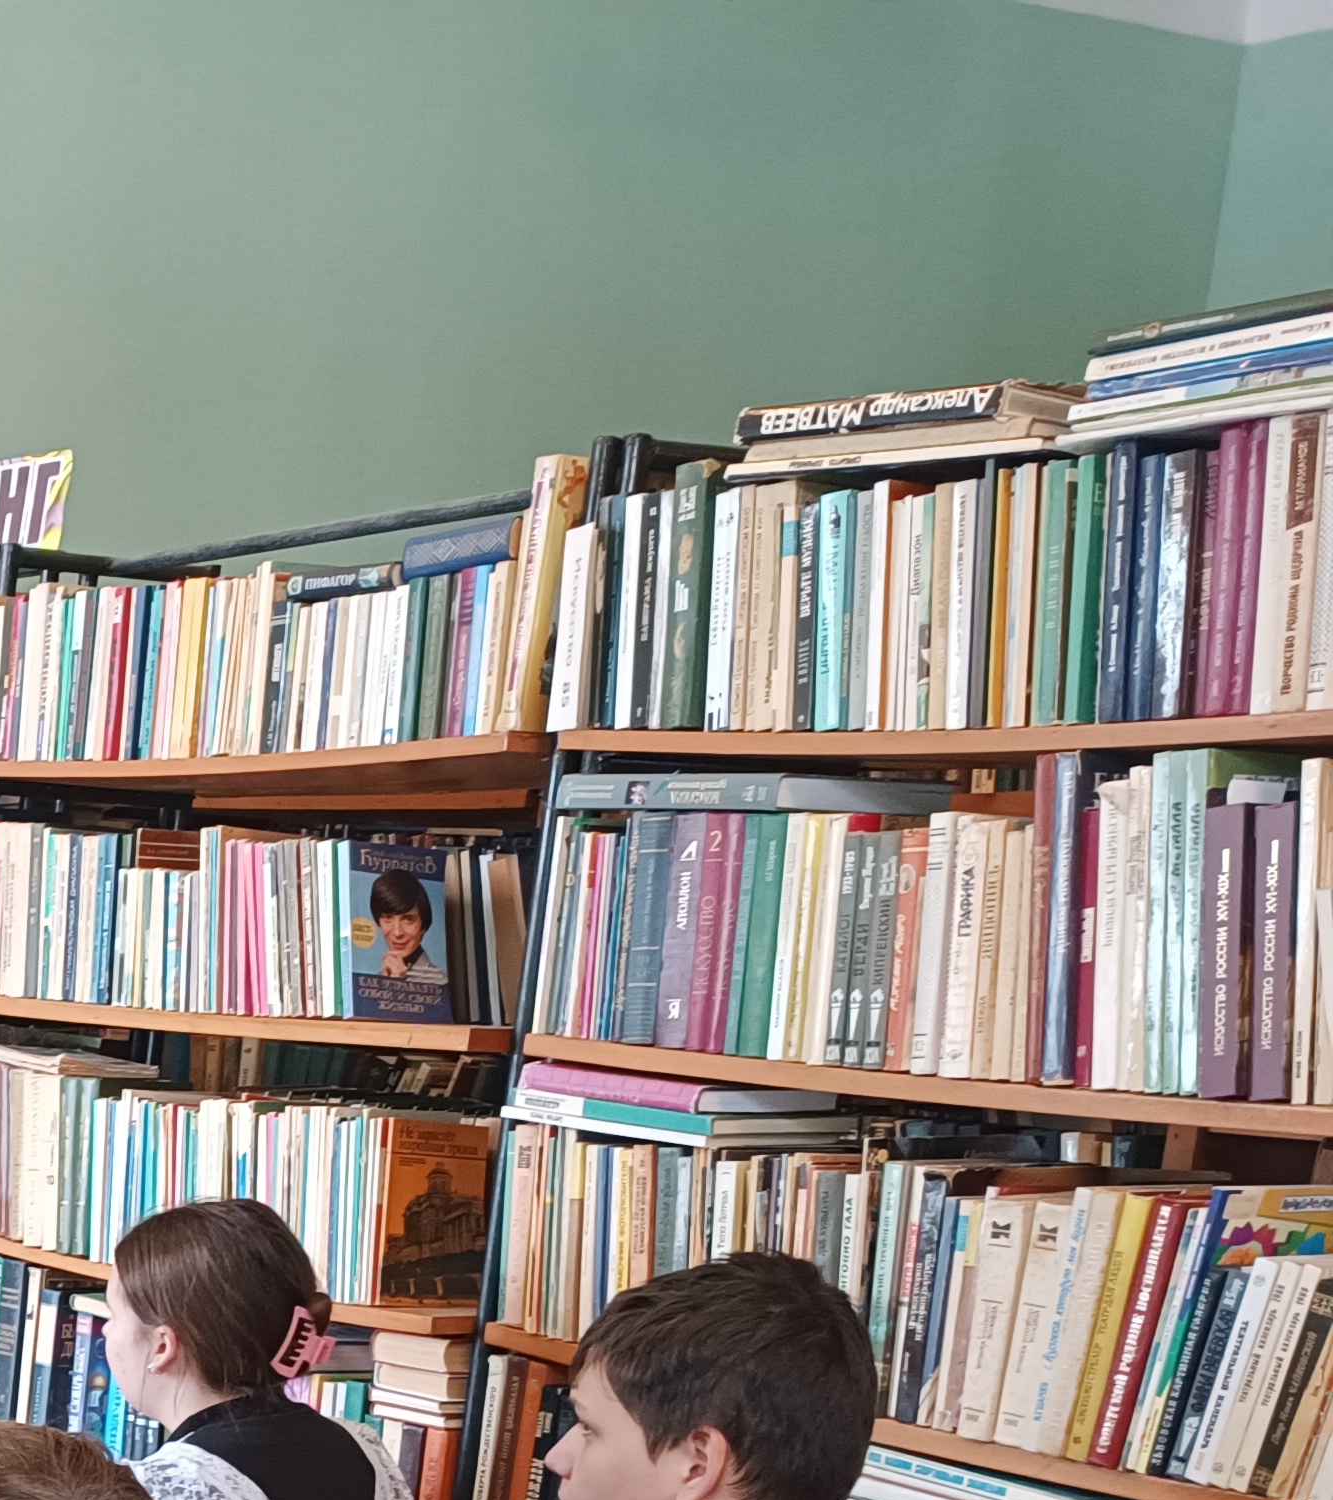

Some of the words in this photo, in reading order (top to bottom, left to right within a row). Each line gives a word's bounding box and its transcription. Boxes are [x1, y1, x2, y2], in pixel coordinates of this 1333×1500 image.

[760, 402, 865, 436] МАТВЕЕВ
[869, 387, 993, 420] Александр
[304, 573, 356, 592] ПИФАГОР
[909, 533, 923, 596] Диапазон
[1290, 529, 1304, 580] ЩЕДРИНА
[564, 556, 583, 668] Искусство
[1286, 583, 1301, 632] РОДИОНА
[561, 681, 572, 709] 85
[1279, 635, 1296, 697] ТВОРЧЕСТВО
[673, 871, 693, 930] АПОЛЛОН
[691, 895, 715, 996] ИСКУССТВО
[708, 829, 724, 853] 2
[956, 865, 976, 938] ГРАФИКА
[980, 863, 1002, 960] ЖИВОПИСЬ
[835, 913, 851, 974] КАТАЛОГ
[852, 922, 871, 977] ВЕРДИ
[872, 897, 891, 986] КИПРЕНСКИЙ
[1213, 926, 1229, 979] РОССИИ
[1261, 919, 1278, 972] РОССИИ
[1212, 983, 1228, 1057] ИСКУССТВО
[1259, 976, 1277, 1051] ИСКУССТВО
[844, 1197, 854, 1230] ГАЛА
[839, 1234, 851, 1292] НТОНИО
[1096, 1375, 1129, 1454] СОВЕТСКОЙ
[1120, 1313, 1147, 1371] РОДИНЕ
[1134, 1205, 1172, 1311] ПОСВЯЩАЕТСЯ
[1219, 1319, 1250, 1391] ТЕАТРАЛЬНЫЙ
[1151, 1400, 1177, 1467] ЛЬВОВСКАЯ
[1168, 1331, 1200, 1399] КАРТИННАЯ
[1186, 1277, 1212, 1331] ГАЛЕРЕЯ
[1284, 1331, 1319, 1394] ЧАЙКОВСКИЙ
[478, 1385, 497, 1469] РОЖДЕСТВЕНСКОГО
[1200, 1394, 1226, 1450] КАЛЕНДАРЬ
